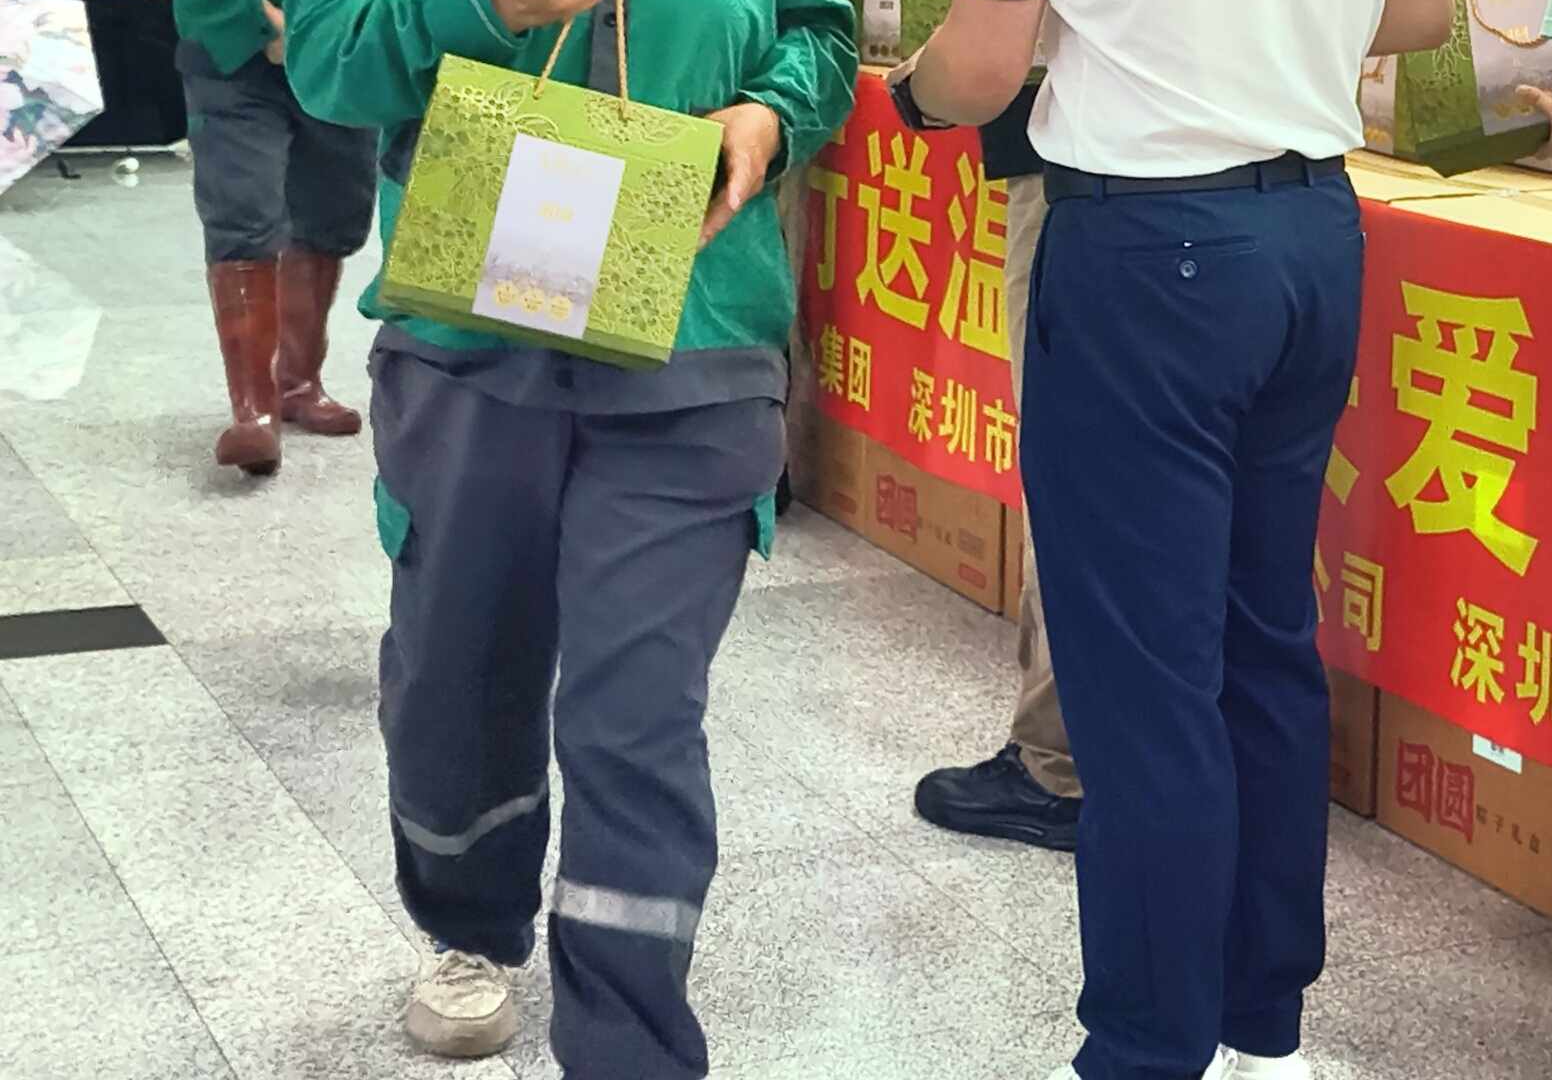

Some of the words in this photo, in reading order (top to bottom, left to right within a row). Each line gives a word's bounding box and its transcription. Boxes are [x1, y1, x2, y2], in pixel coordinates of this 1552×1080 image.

[819, 324, 871, 411] 集团
[908, 367, 1017, 473] 深圳市
